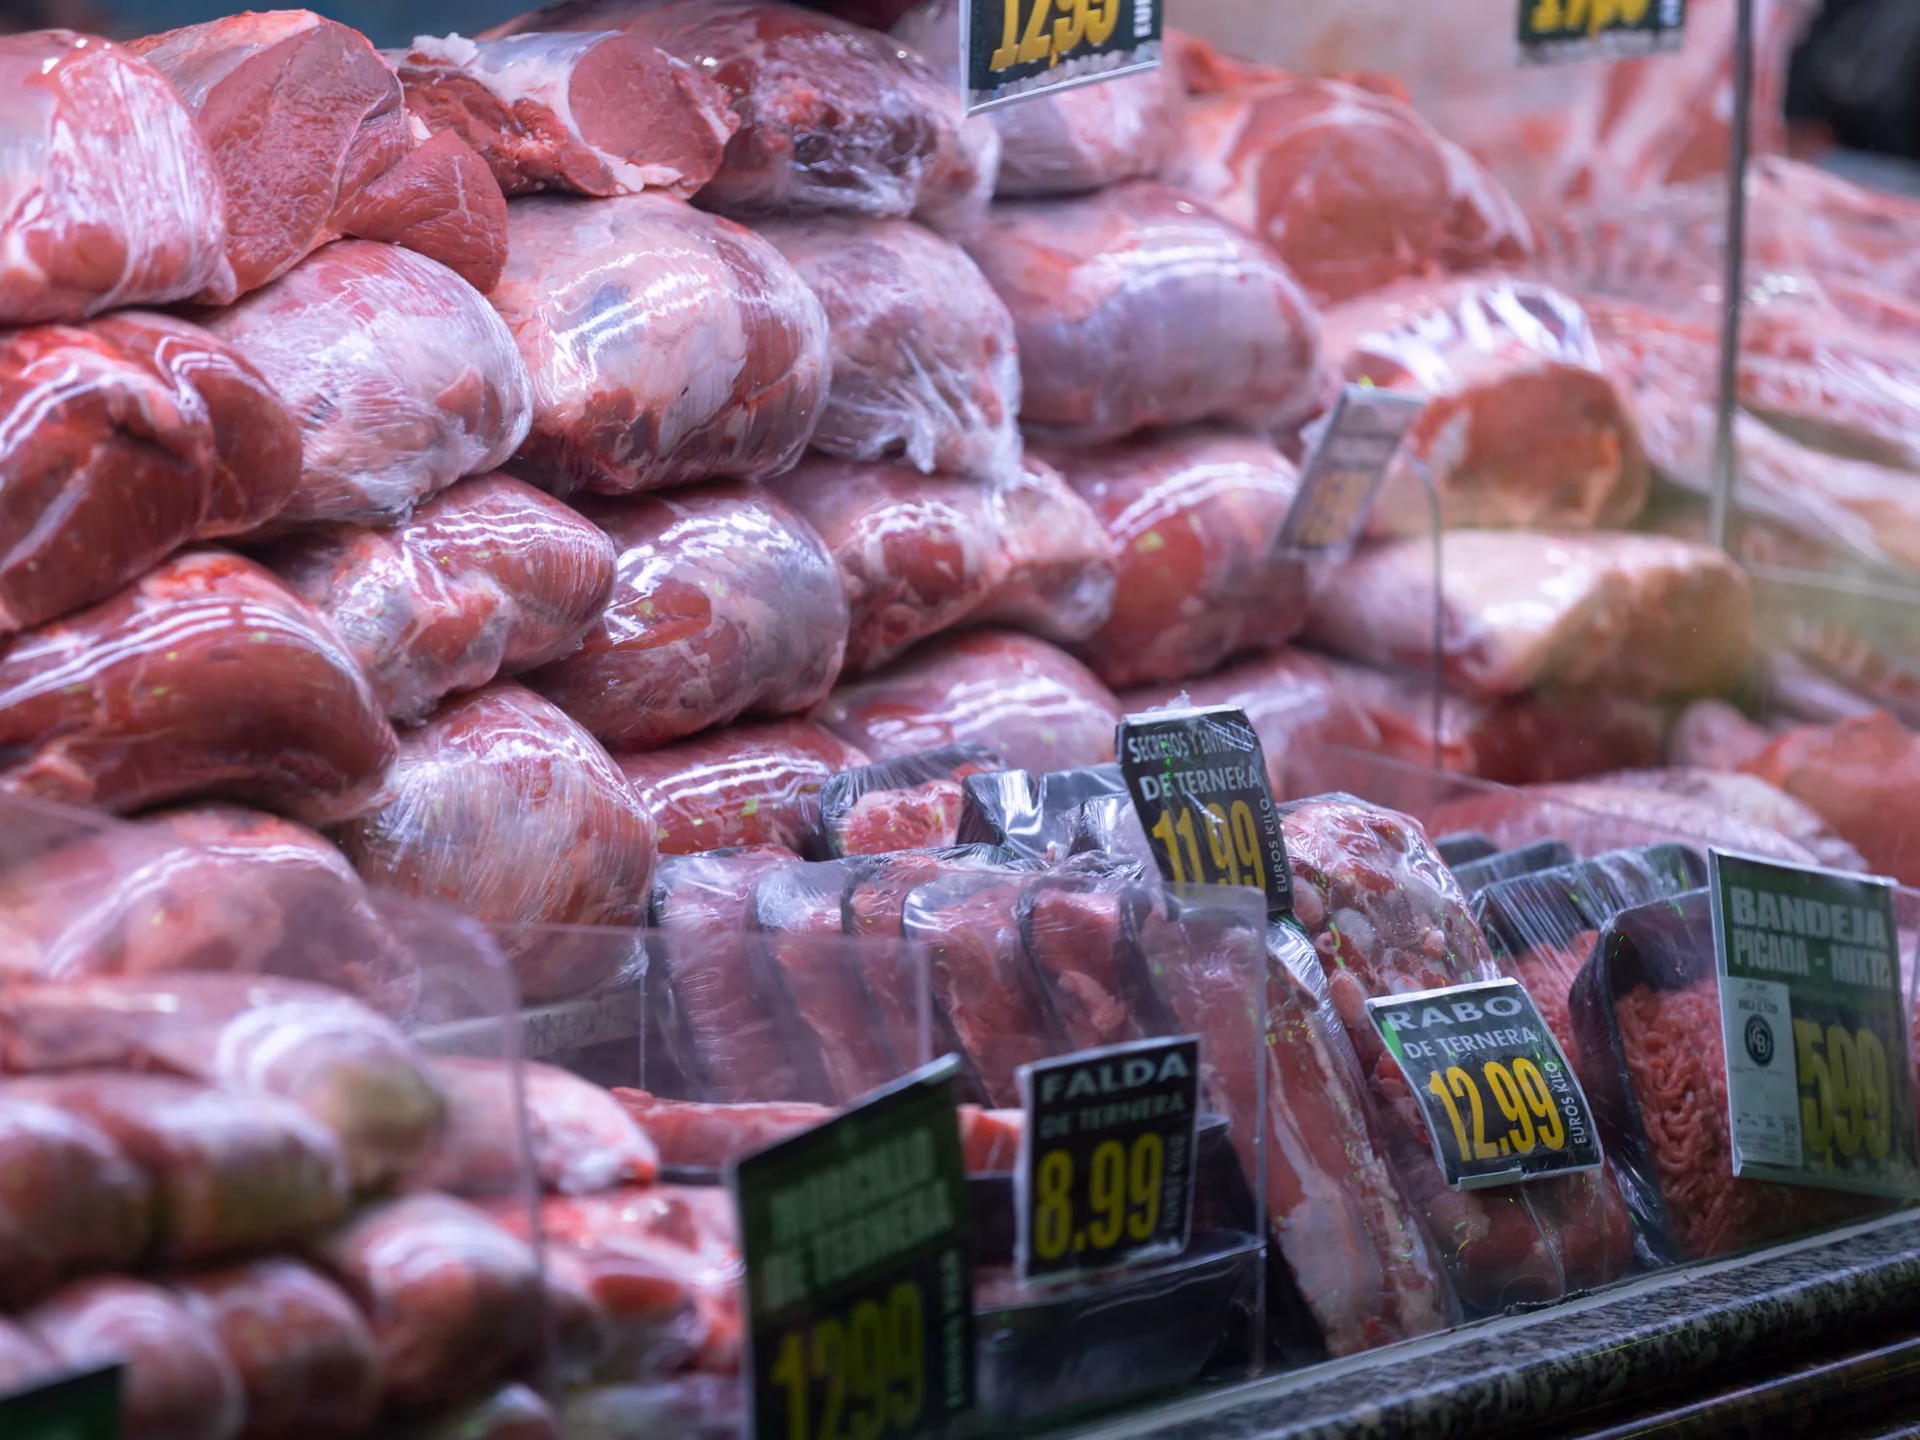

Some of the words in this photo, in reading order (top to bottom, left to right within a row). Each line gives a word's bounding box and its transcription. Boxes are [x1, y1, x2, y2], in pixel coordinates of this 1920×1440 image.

[1139, 774, 1177, 802] DE
[1177, 764, 1263, 796] TERNERA
[1259, 799, 1277, 836] KILO
[1267, 840, 1288, 893] EUROS
[1730, 885, 1889, 948] BANDEJA
[1733, 929, 1810, 977] PICADA
[1384, 996, 1523, 1032] RABO
[1403, 1041, 1437, 1059] DE
[1438, 1027, 1539, 1055] TERNERA
[1040, 1052, 1189, 1105] FALDA
[1544, 1061, 1569, 1093] KILO
[1794, 1018, 1894, 1174] 5,99
[1428, 1057, 1565, 1162] 12.99
[1561, 1096, 1588, 1145] EUROS
[1035, 1132, 1163, 1260] 8.99
